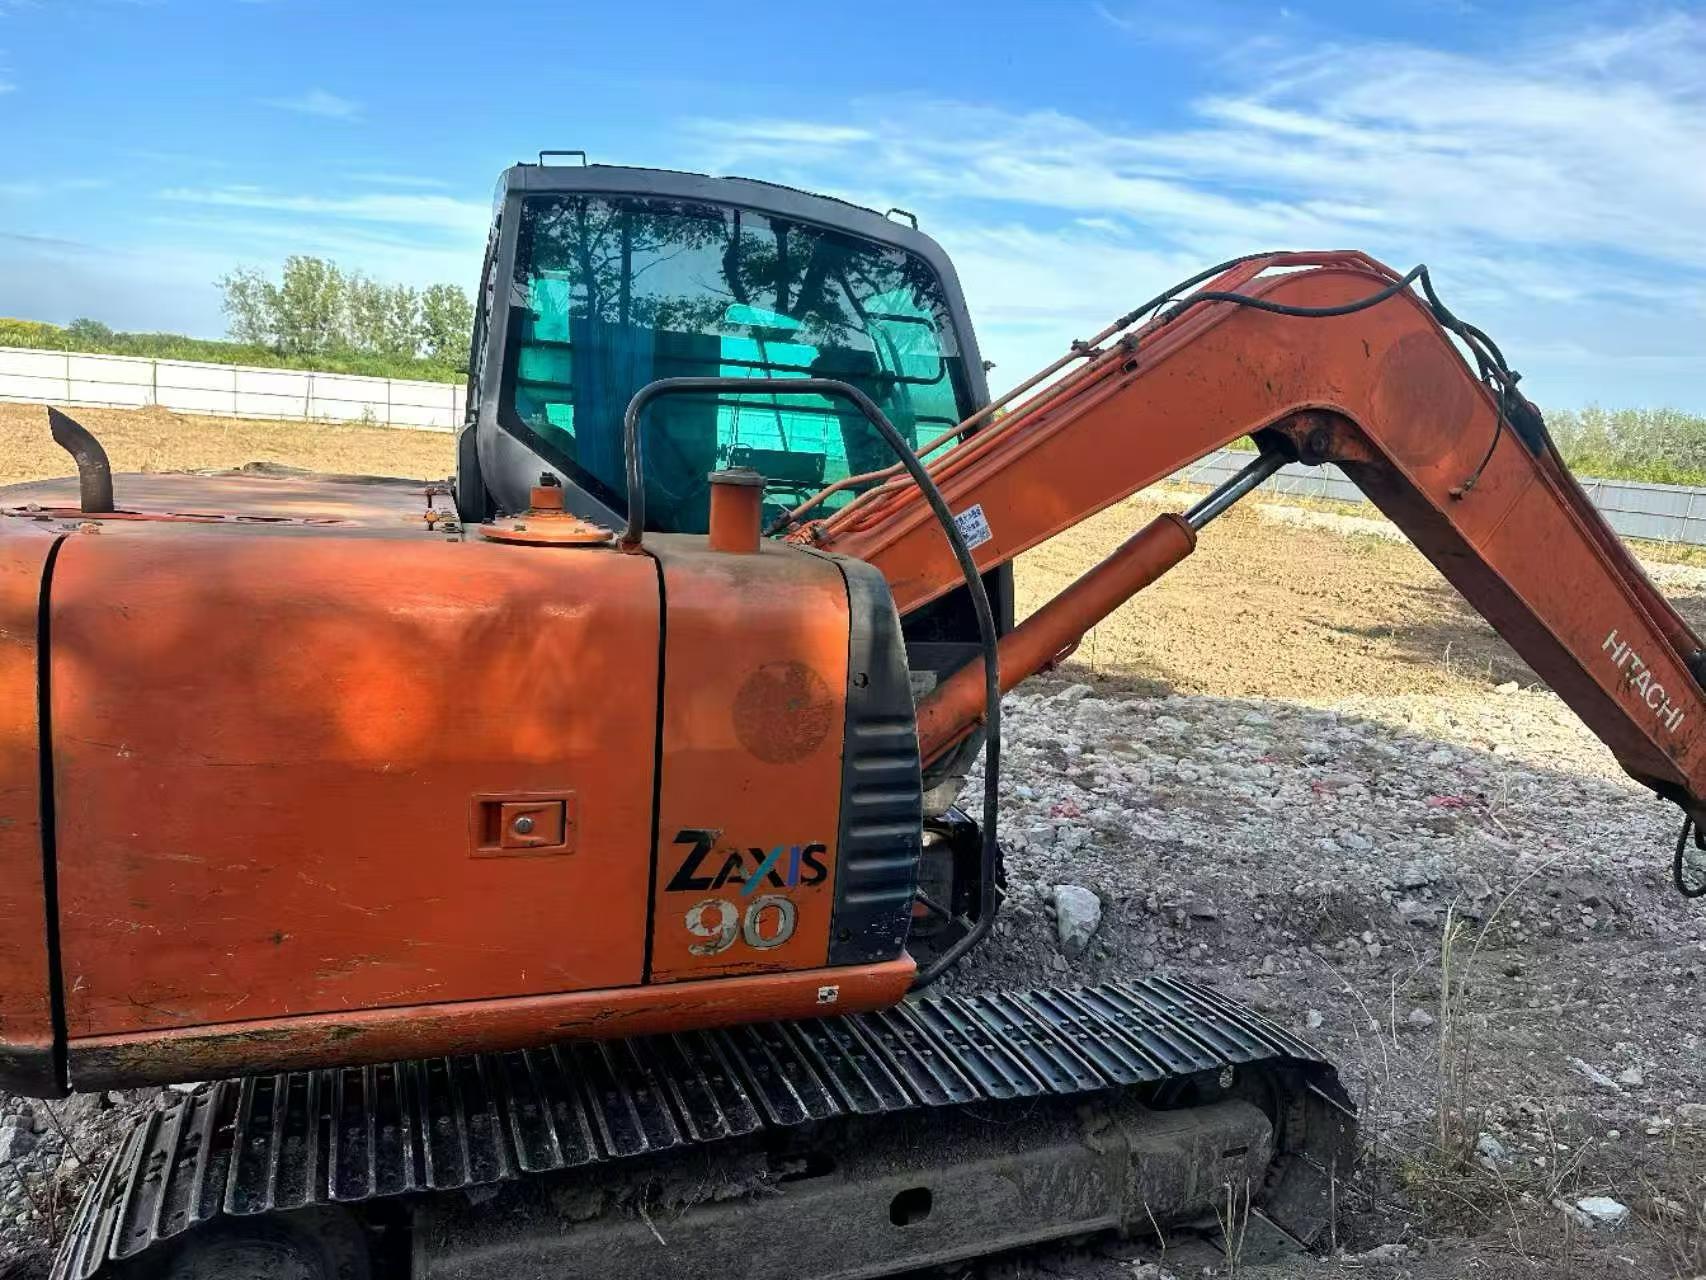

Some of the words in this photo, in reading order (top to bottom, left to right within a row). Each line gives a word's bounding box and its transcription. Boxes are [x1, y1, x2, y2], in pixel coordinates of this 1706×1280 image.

[1601, 629, 1685, 733] HITACHI
[665, 828, 828, 896] ZAXIS
[684, 894, 799, 956] 90
